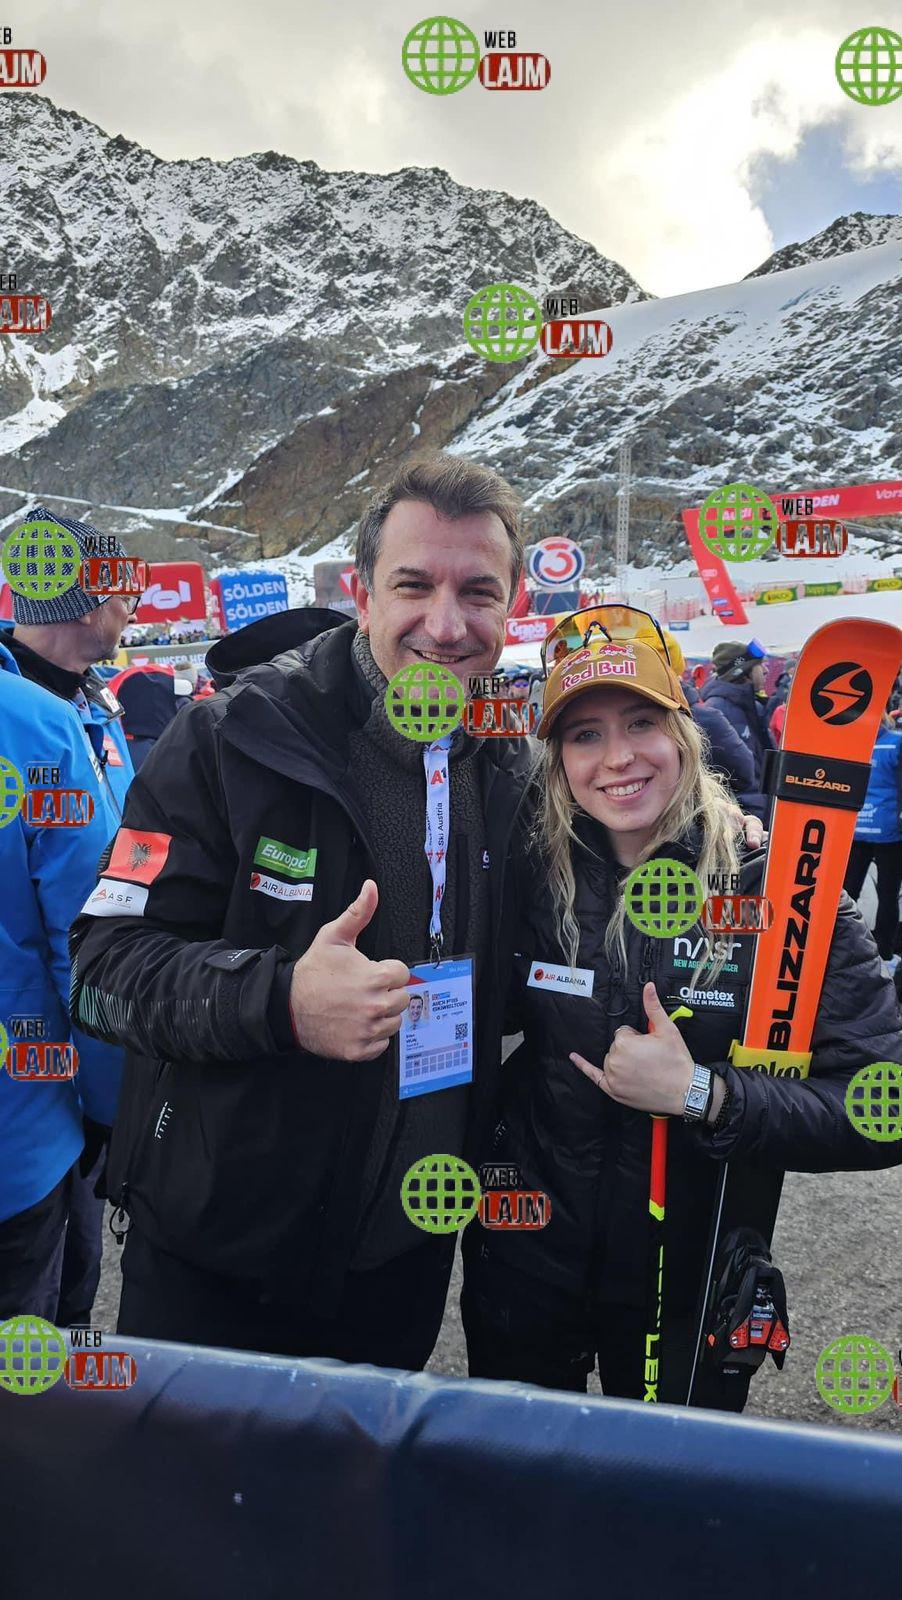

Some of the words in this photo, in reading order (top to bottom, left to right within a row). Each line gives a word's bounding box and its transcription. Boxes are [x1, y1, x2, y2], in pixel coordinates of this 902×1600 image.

[223, 580, 286, 602] SÖLDEN
[226, 600, 288, 621] SÖLDEN
[561, 662, 594, 692] Red
[598, 661, 637, 676] Bull
[785, 774, 851, 793] BLIZZARD
[437, 835, 445, 846] Ski
[767, 818, 826, 1051] BLIZZARD
[673, 959, 688, 968] NEW
[722, 963, 739, 973] ACER
[557, 975, 587, 987] ALBANIA
